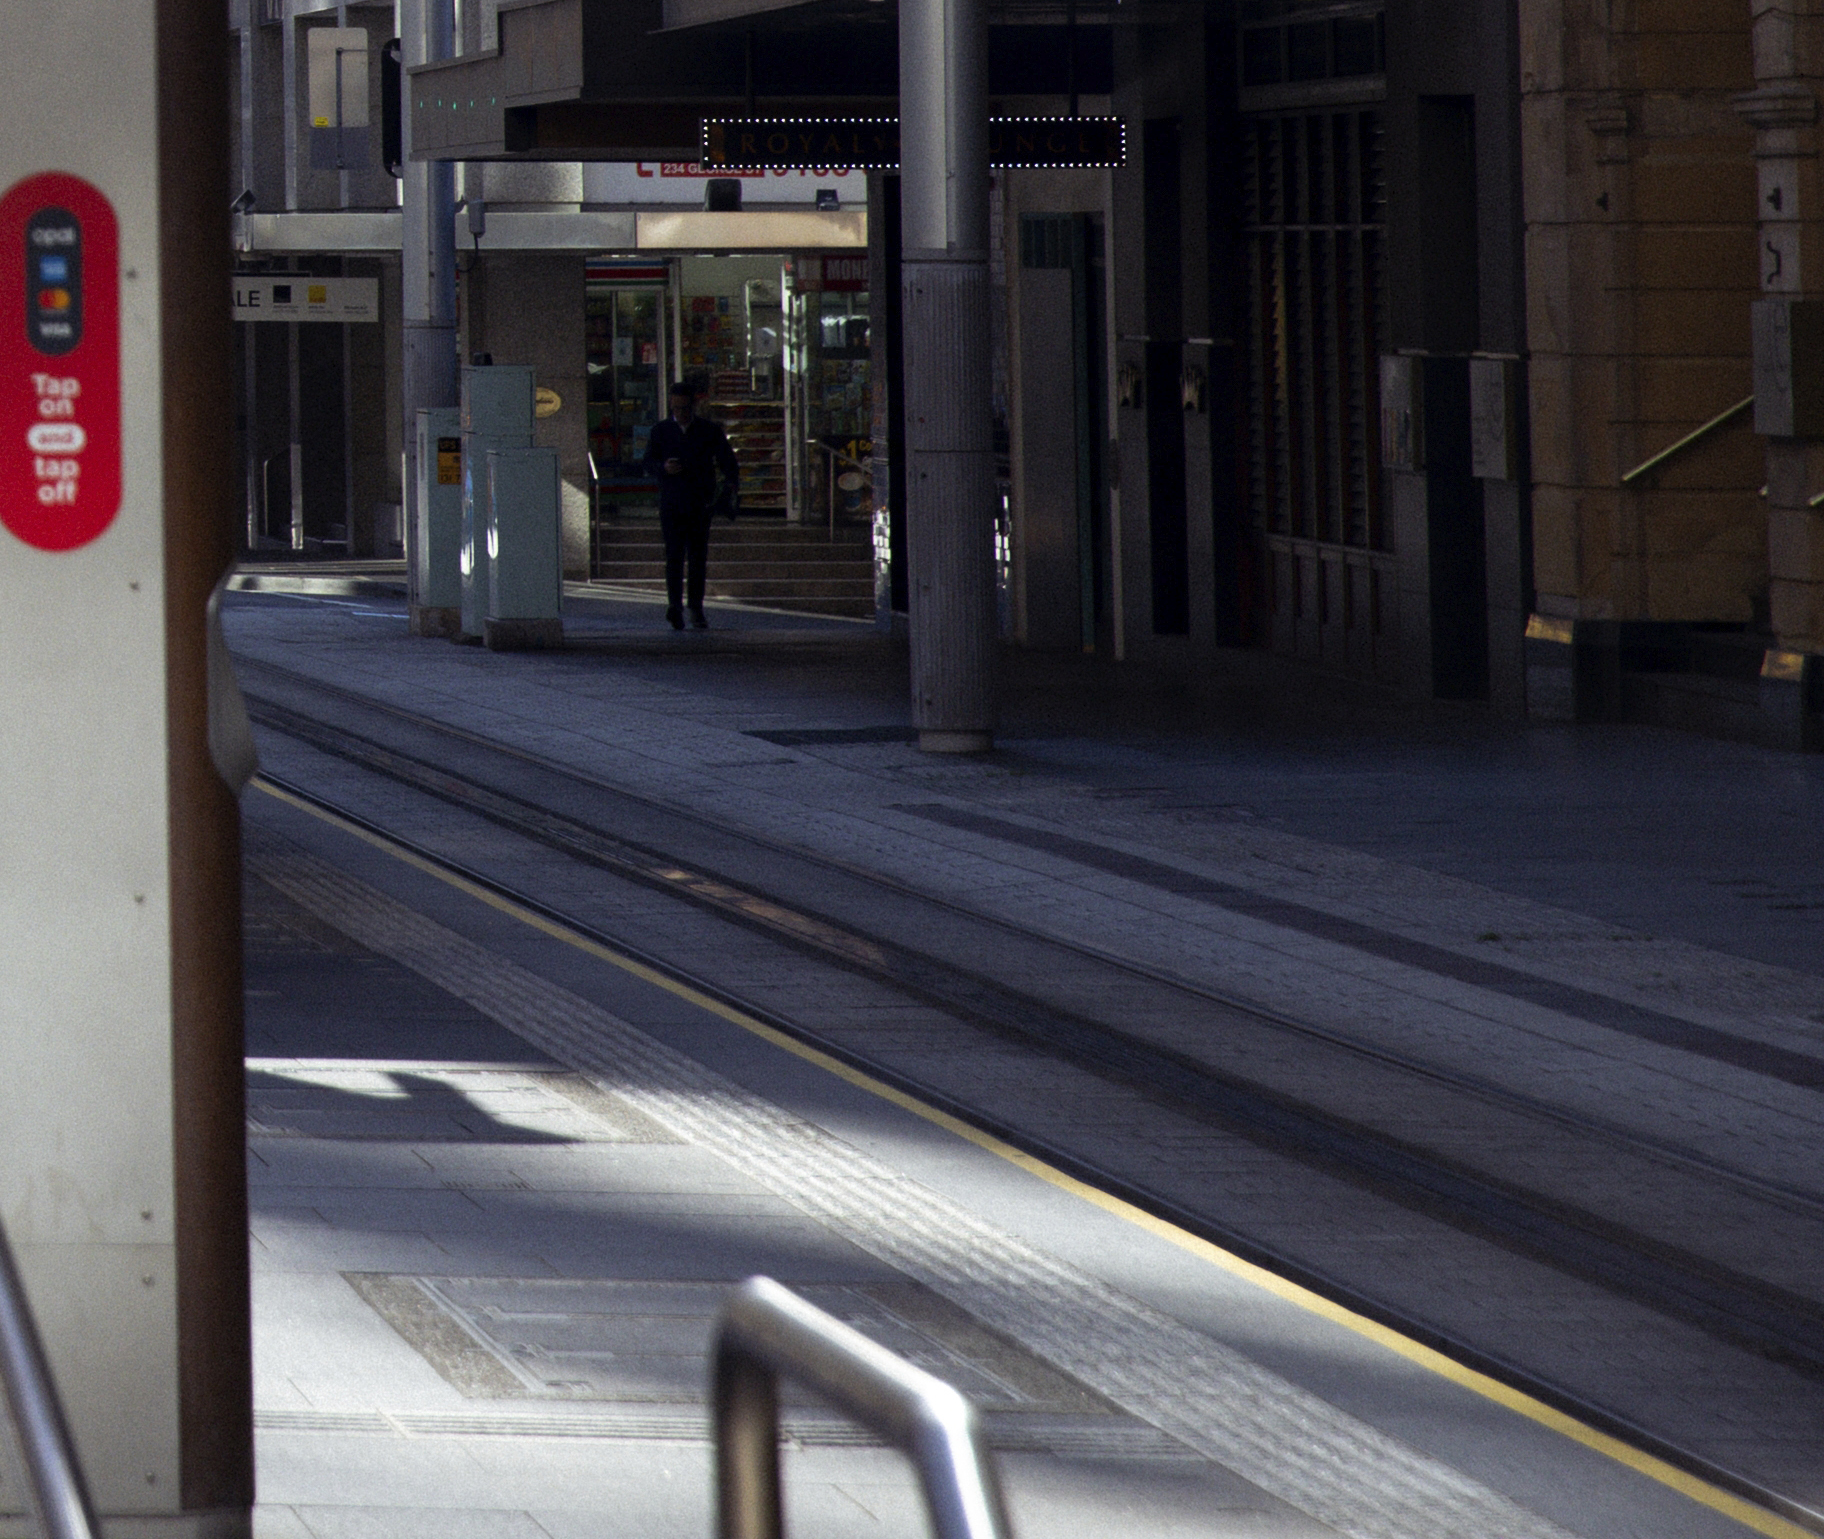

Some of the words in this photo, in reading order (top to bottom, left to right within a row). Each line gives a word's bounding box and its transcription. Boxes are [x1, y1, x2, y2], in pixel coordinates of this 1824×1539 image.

[31, 227, 76, 247] opal
[31, 374, 81, 401] Tap
[38, 400, 75, 417] on
[34, 457, 80, 480] tap
[37, 483, 76, 507] off
